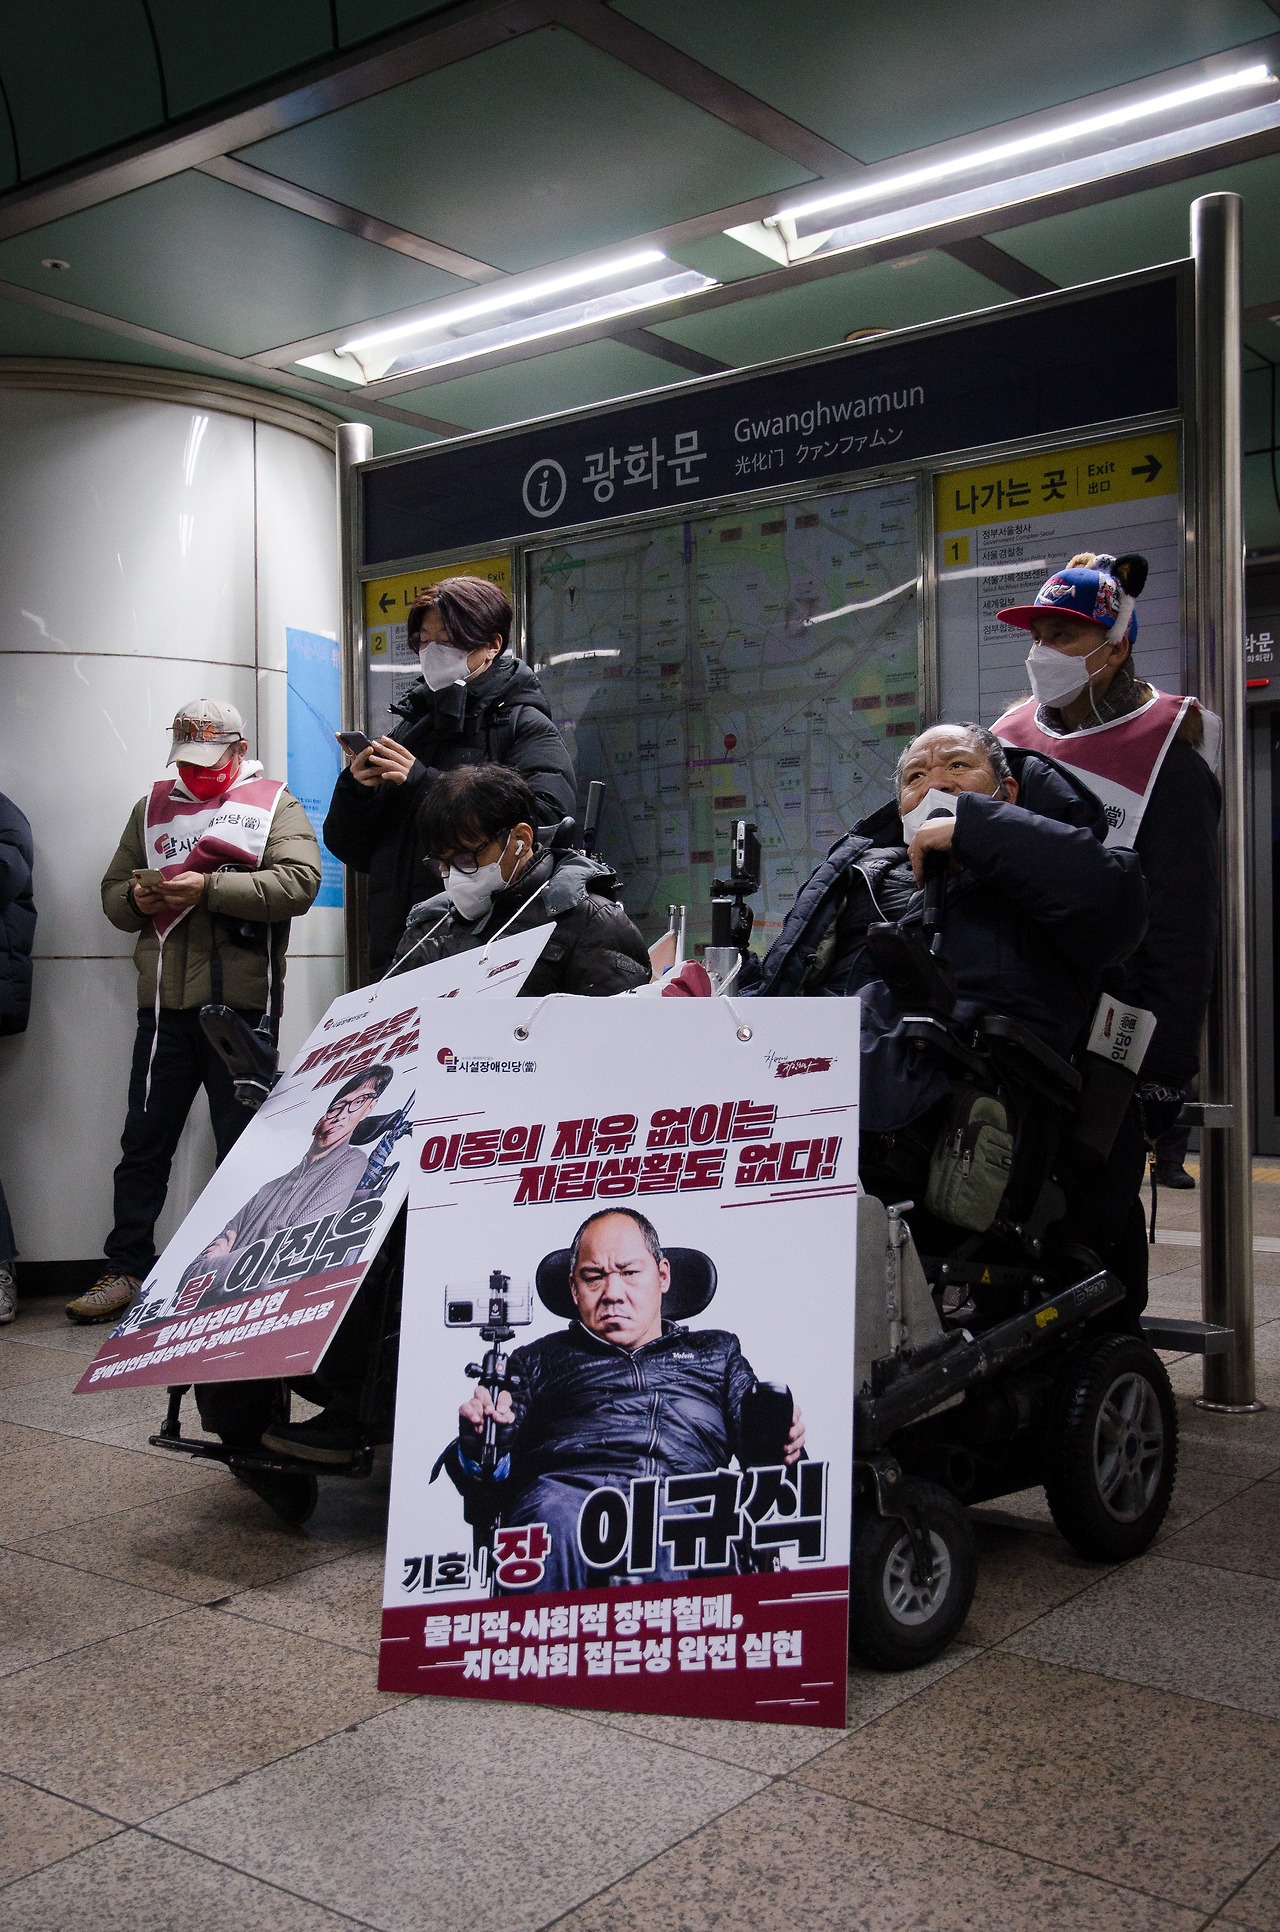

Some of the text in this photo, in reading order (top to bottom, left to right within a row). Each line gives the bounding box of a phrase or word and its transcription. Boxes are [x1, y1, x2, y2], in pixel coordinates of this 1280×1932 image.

[734, 385, 925, 443] Gwanghwamun
[582, 430, 707, 502] 광화문
[735, 428, 903, 476] 光化门 クァンファムン
[1088, 461, 1115, 477] Exit
[955, 469, 1067, 515] 나가는 곳
[1088, 481, 1111, 495] 出口
[951, 542, 960, 561] 1
[982, 523, 1032, 540] 정부서울청사
[487, 571, 505, 582] Exit
[374, 635, 383, 650] 2
[419, 1100, 778, 1173] 이동의 자유 없이는
[513, 1135, 842, 1207] 자립생활도 없다!
[174, 1270, 218, 1315] 탈
[224, 1198, 386, 1292] 이진우
[153, 1289, 290, 1348] 탈시설권리 실현
[400, 1459, 830, 1592] 기호 장 이규식
[424, 1594, 745, 1647] 물리적·사회적 장벽철폐,
[463, 1630, 803, 1681] 지역사회 접근성 완전 실현
